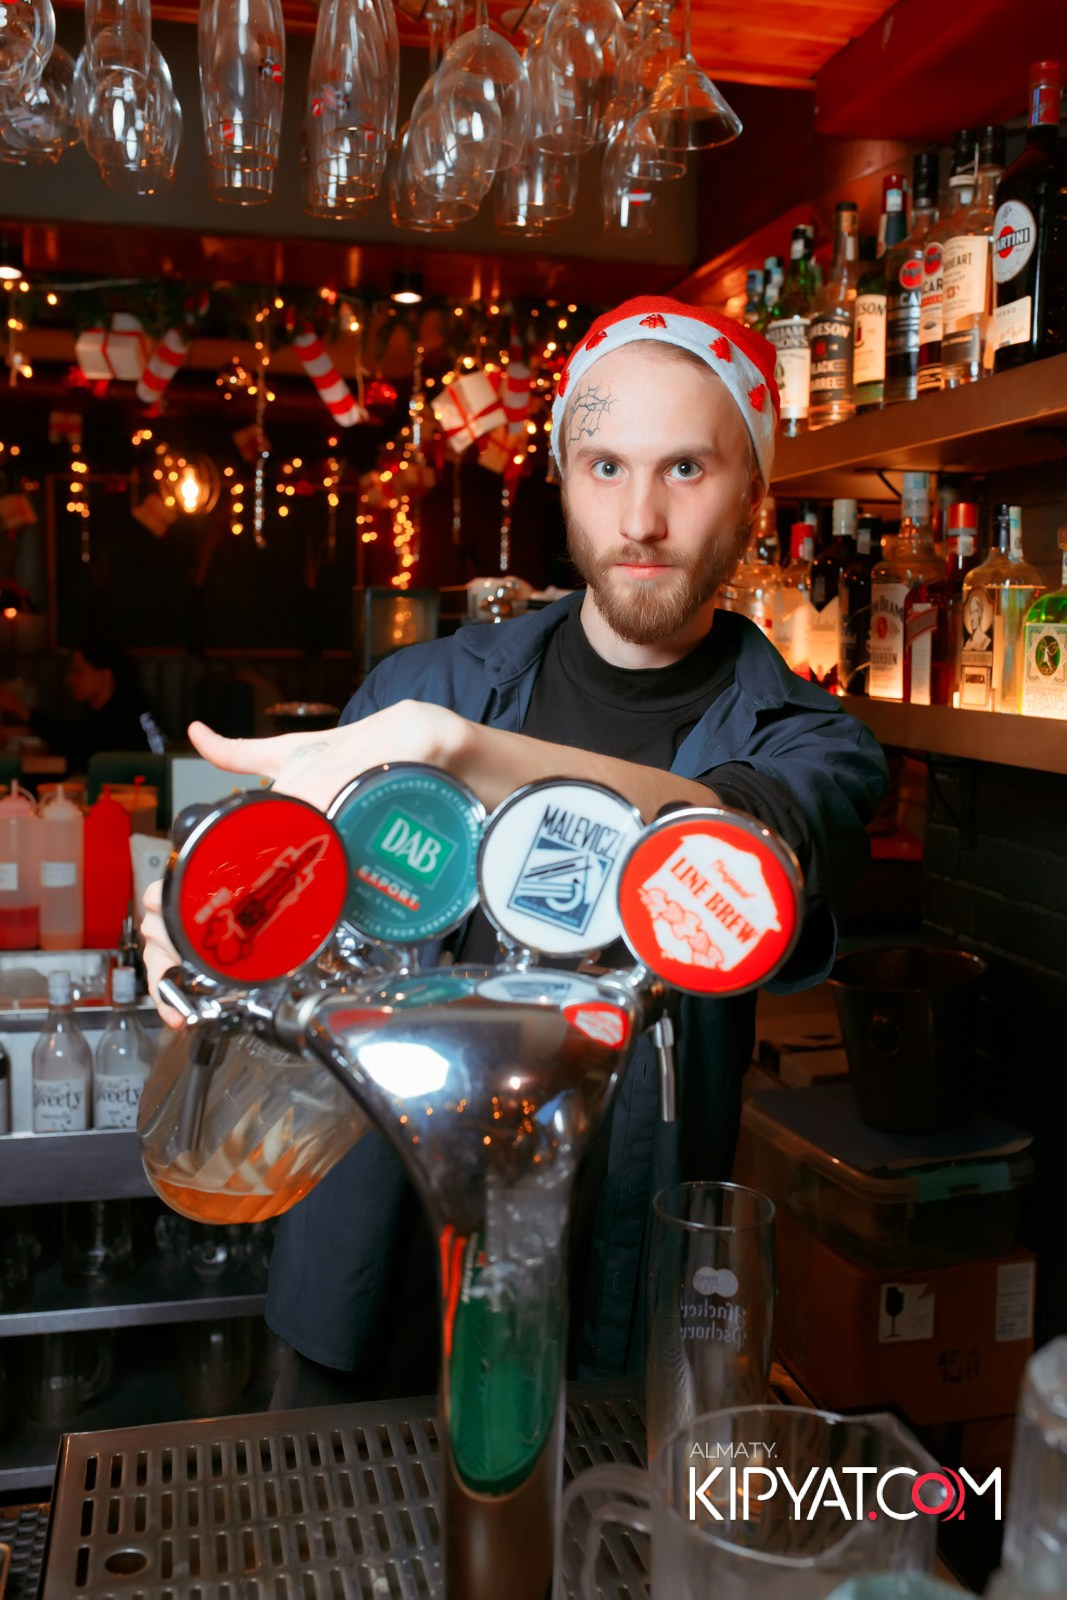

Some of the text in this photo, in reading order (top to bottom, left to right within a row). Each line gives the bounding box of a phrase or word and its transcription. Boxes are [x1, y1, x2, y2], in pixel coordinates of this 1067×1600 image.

[380, 816, 442, 874] DAB
[671, 857, 759, 943] LINE BREW
